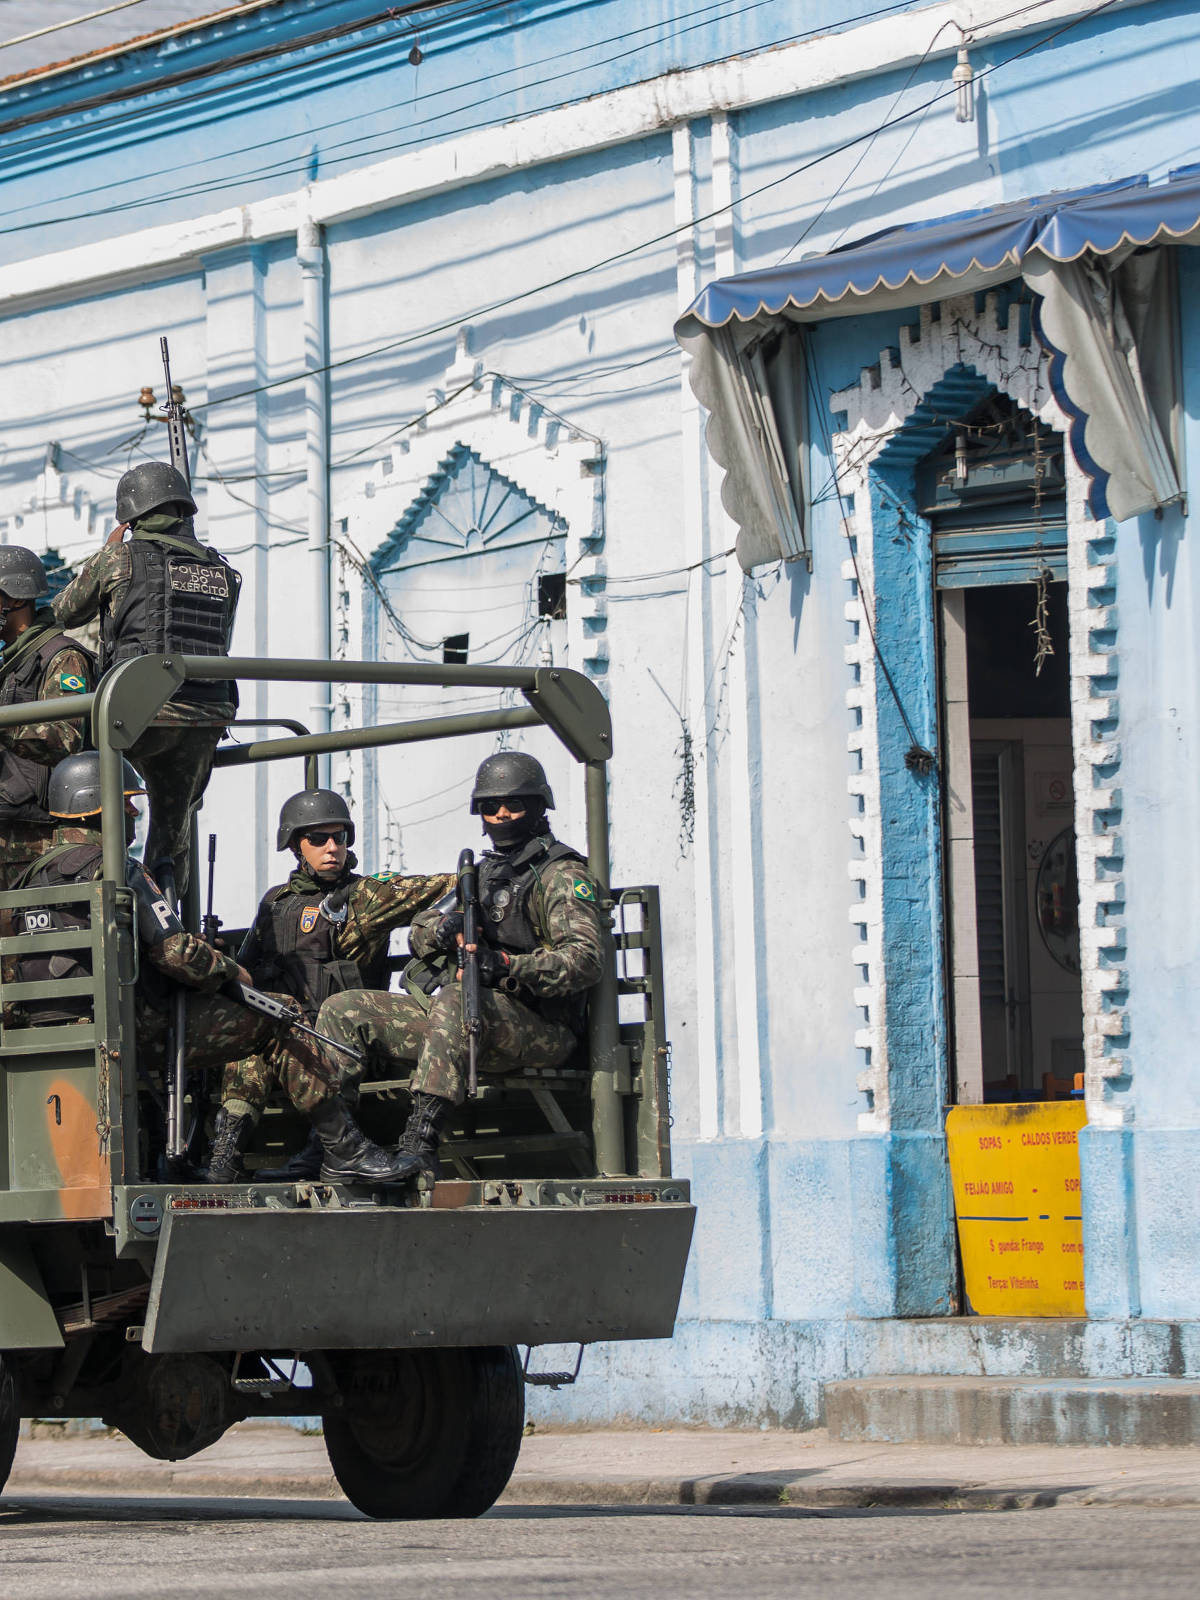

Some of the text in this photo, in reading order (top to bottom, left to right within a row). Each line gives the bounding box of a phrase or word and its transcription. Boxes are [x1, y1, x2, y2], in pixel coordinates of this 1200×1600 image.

[191, 574, 208, 584] DO
[26, 913, 49, 929] DO
[978, 1136, 1002, 1150] SOPAS
[1021, 1132, 1051, 1146] CALDOS
[991, 1181, 1014, 1195] AMIGO
[1021, 1238, 1044, 1255] Frango
[1061, 1242, 1077, 1253] com
[1063, 1280, 1078, 1291] com
